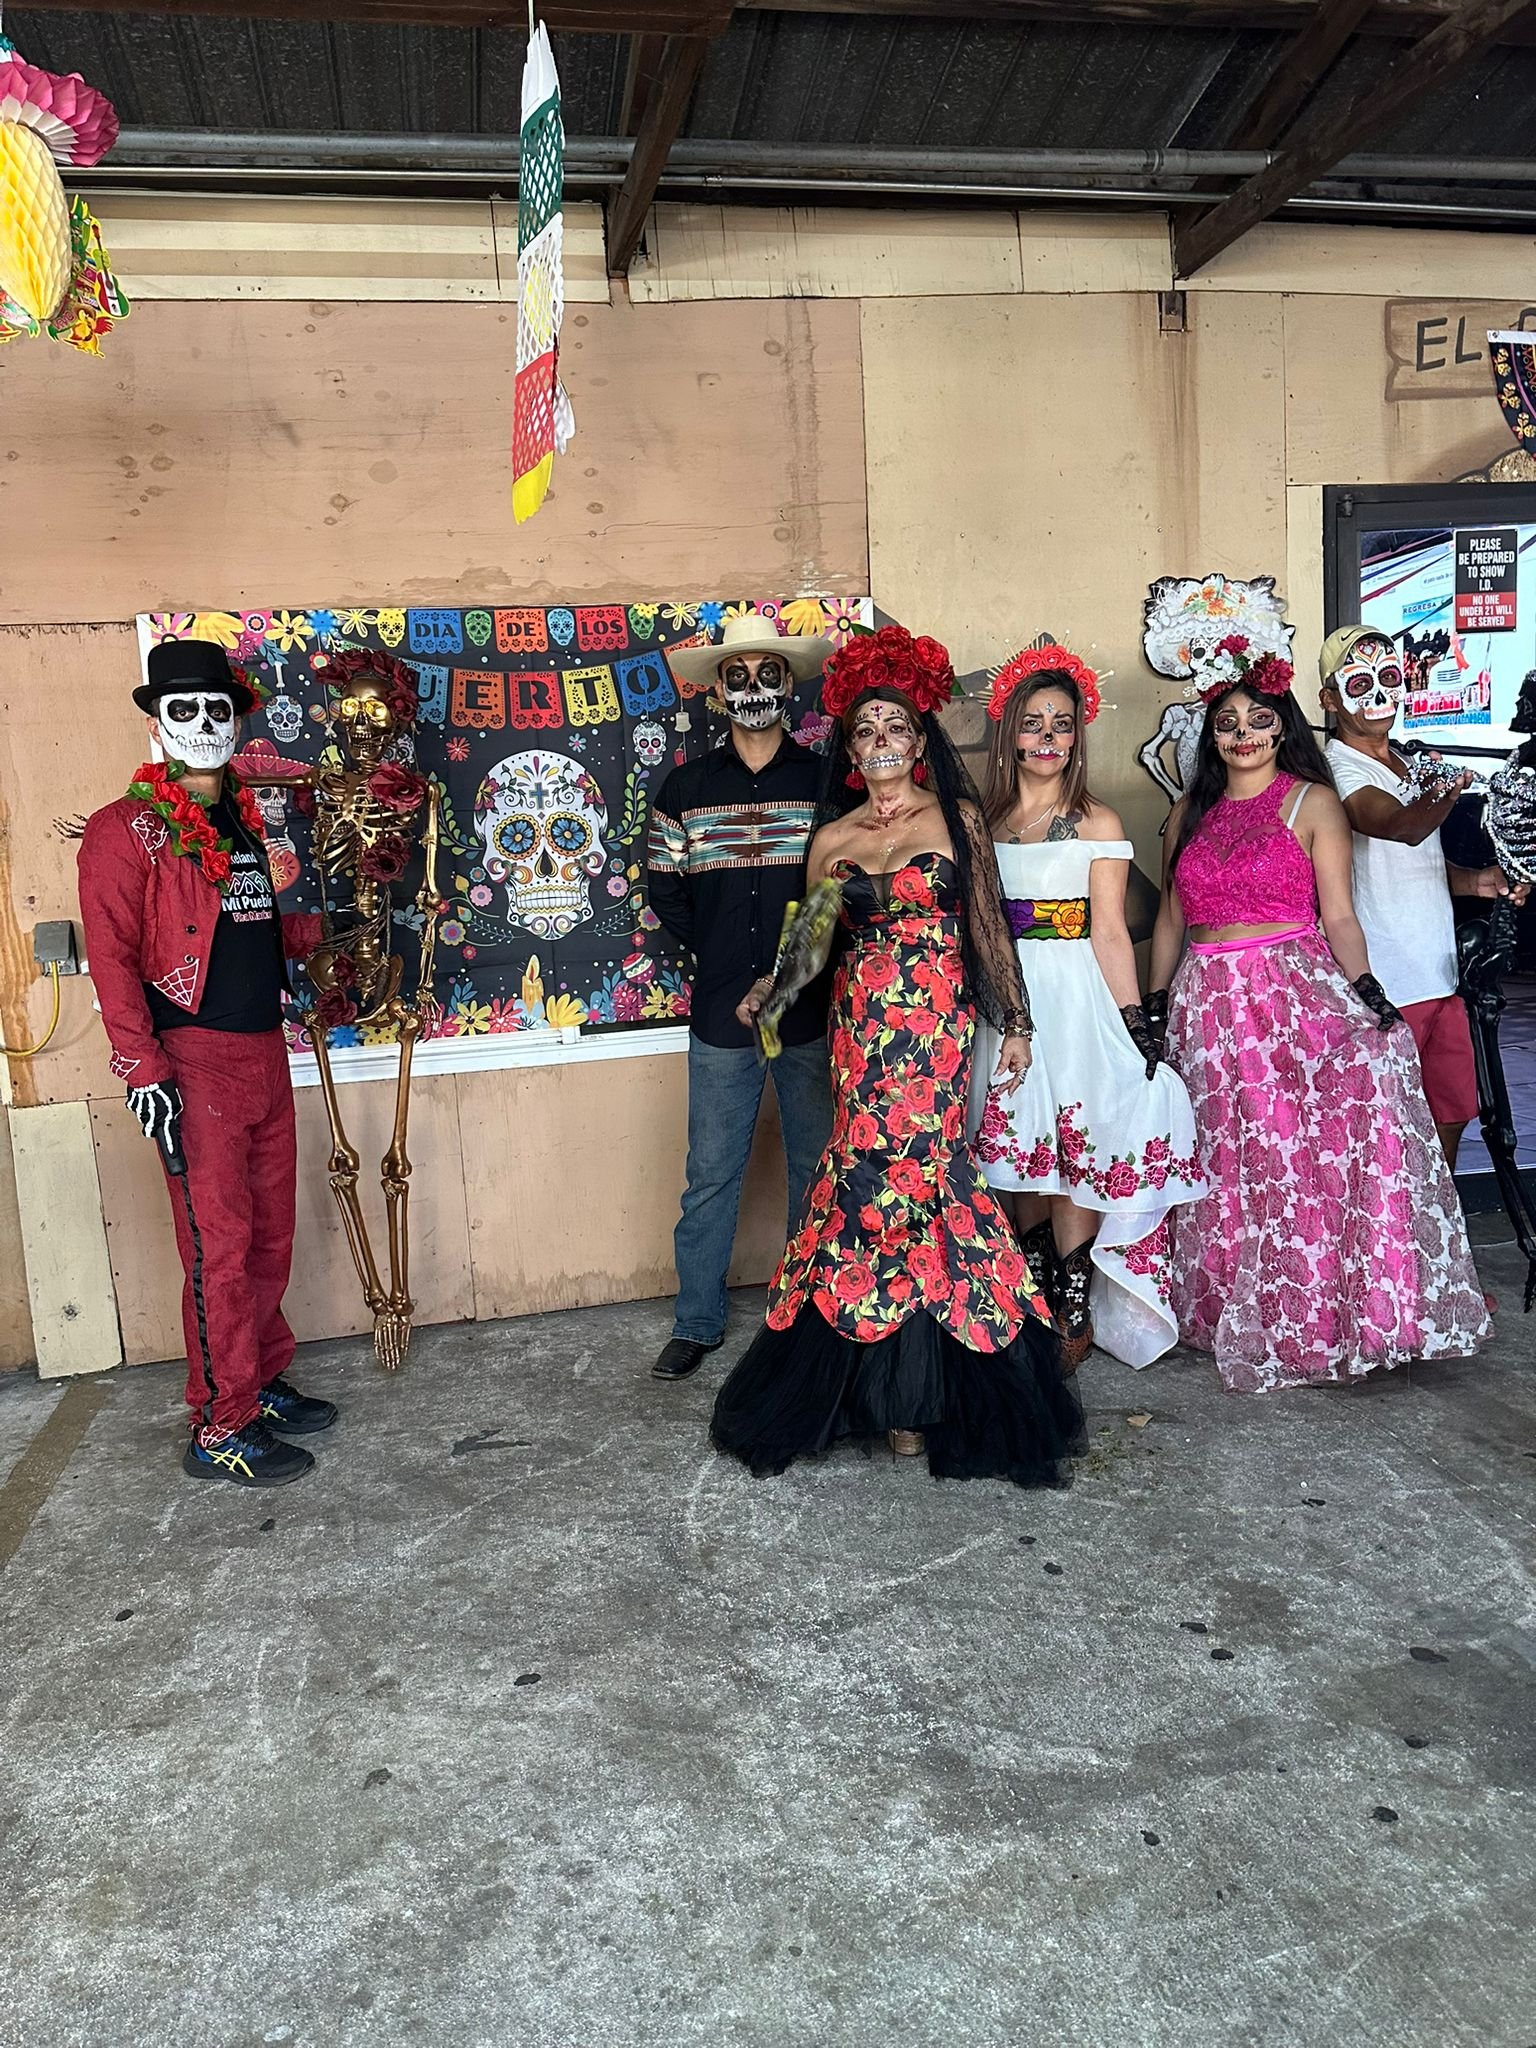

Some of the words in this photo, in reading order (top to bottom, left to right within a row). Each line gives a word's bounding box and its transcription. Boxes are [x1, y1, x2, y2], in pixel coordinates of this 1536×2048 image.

[1416, 316, 1482, 372] EL
[1470, 538, 1501, 551] PLEASE
[1459, 553, 1470, 565] BE
[1471, 551, 1515, 565] PREPARED
[1467, 566, 1478, 578] TO
[1480, 565, 1505, 578] SHOW
[1479, 579, 1493, 591] I.D.
[1472, 595, 1483, 605] NO
[1485, 595, 1500, 605] ONE
[1402, 602, 1437, 614] REGRESA
[1459, 606, 1483, 616] UNDER
[1485, 605, 1494, 615] 21
[1495, 605, 1513, 615] WILL
[414, 622, 457, 638] DIA
[507, 622, 536, 637] DE
[581, 618, 624, 635] LOS
[1467, 617, 1477, 627] BE
[1478, 616, 1505, 626] SERVED
[416, 666, 661, 711] UERTO
[221, 896, 242, 912] Mi
